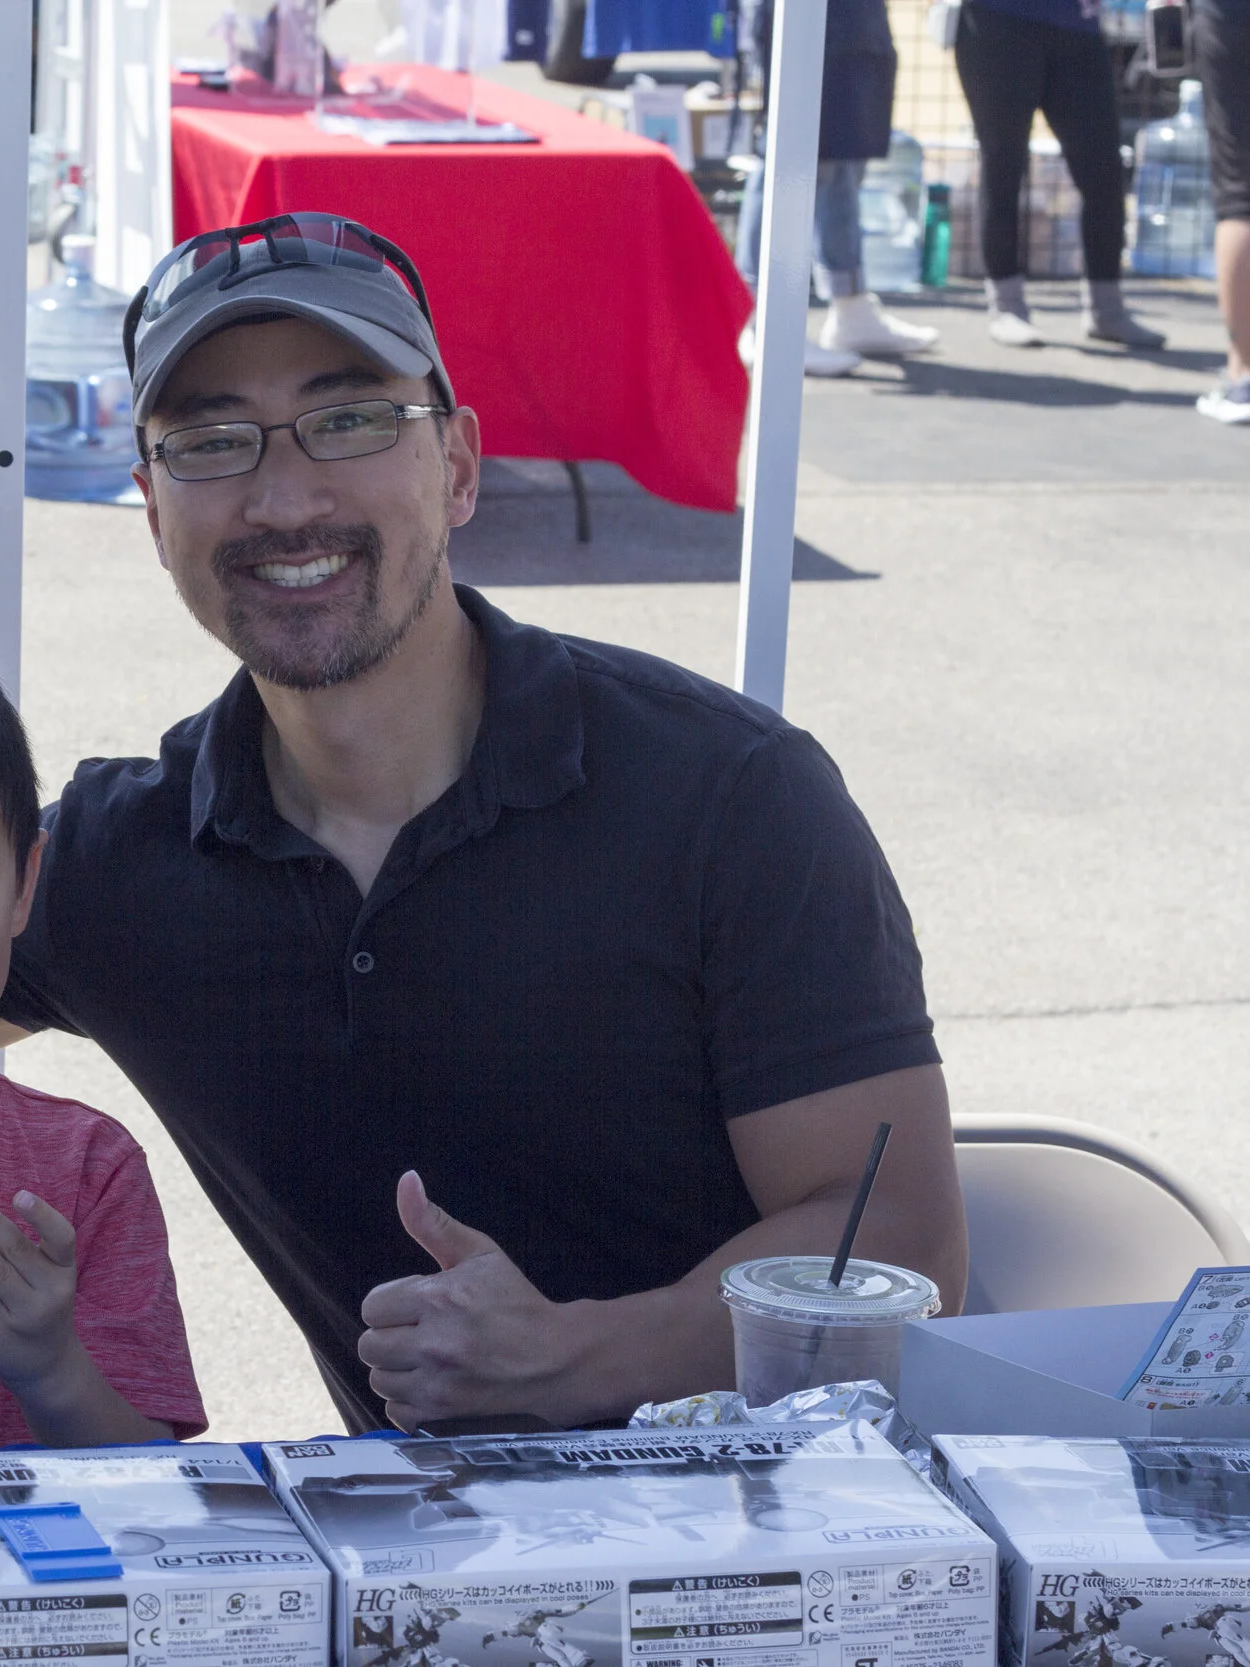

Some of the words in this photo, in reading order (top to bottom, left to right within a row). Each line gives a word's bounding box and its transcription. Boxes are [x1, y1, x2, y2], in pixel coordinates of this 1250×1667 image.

[558, 1446, 707, 1463] GUNDAM
[830, 1527, 971, 1542] GUNPLA
[161, 1553, 306, 1567] GUNPLA
[1036, 1574, 1080, 1598] HG
[353, 1588, 397, 1613] HG
